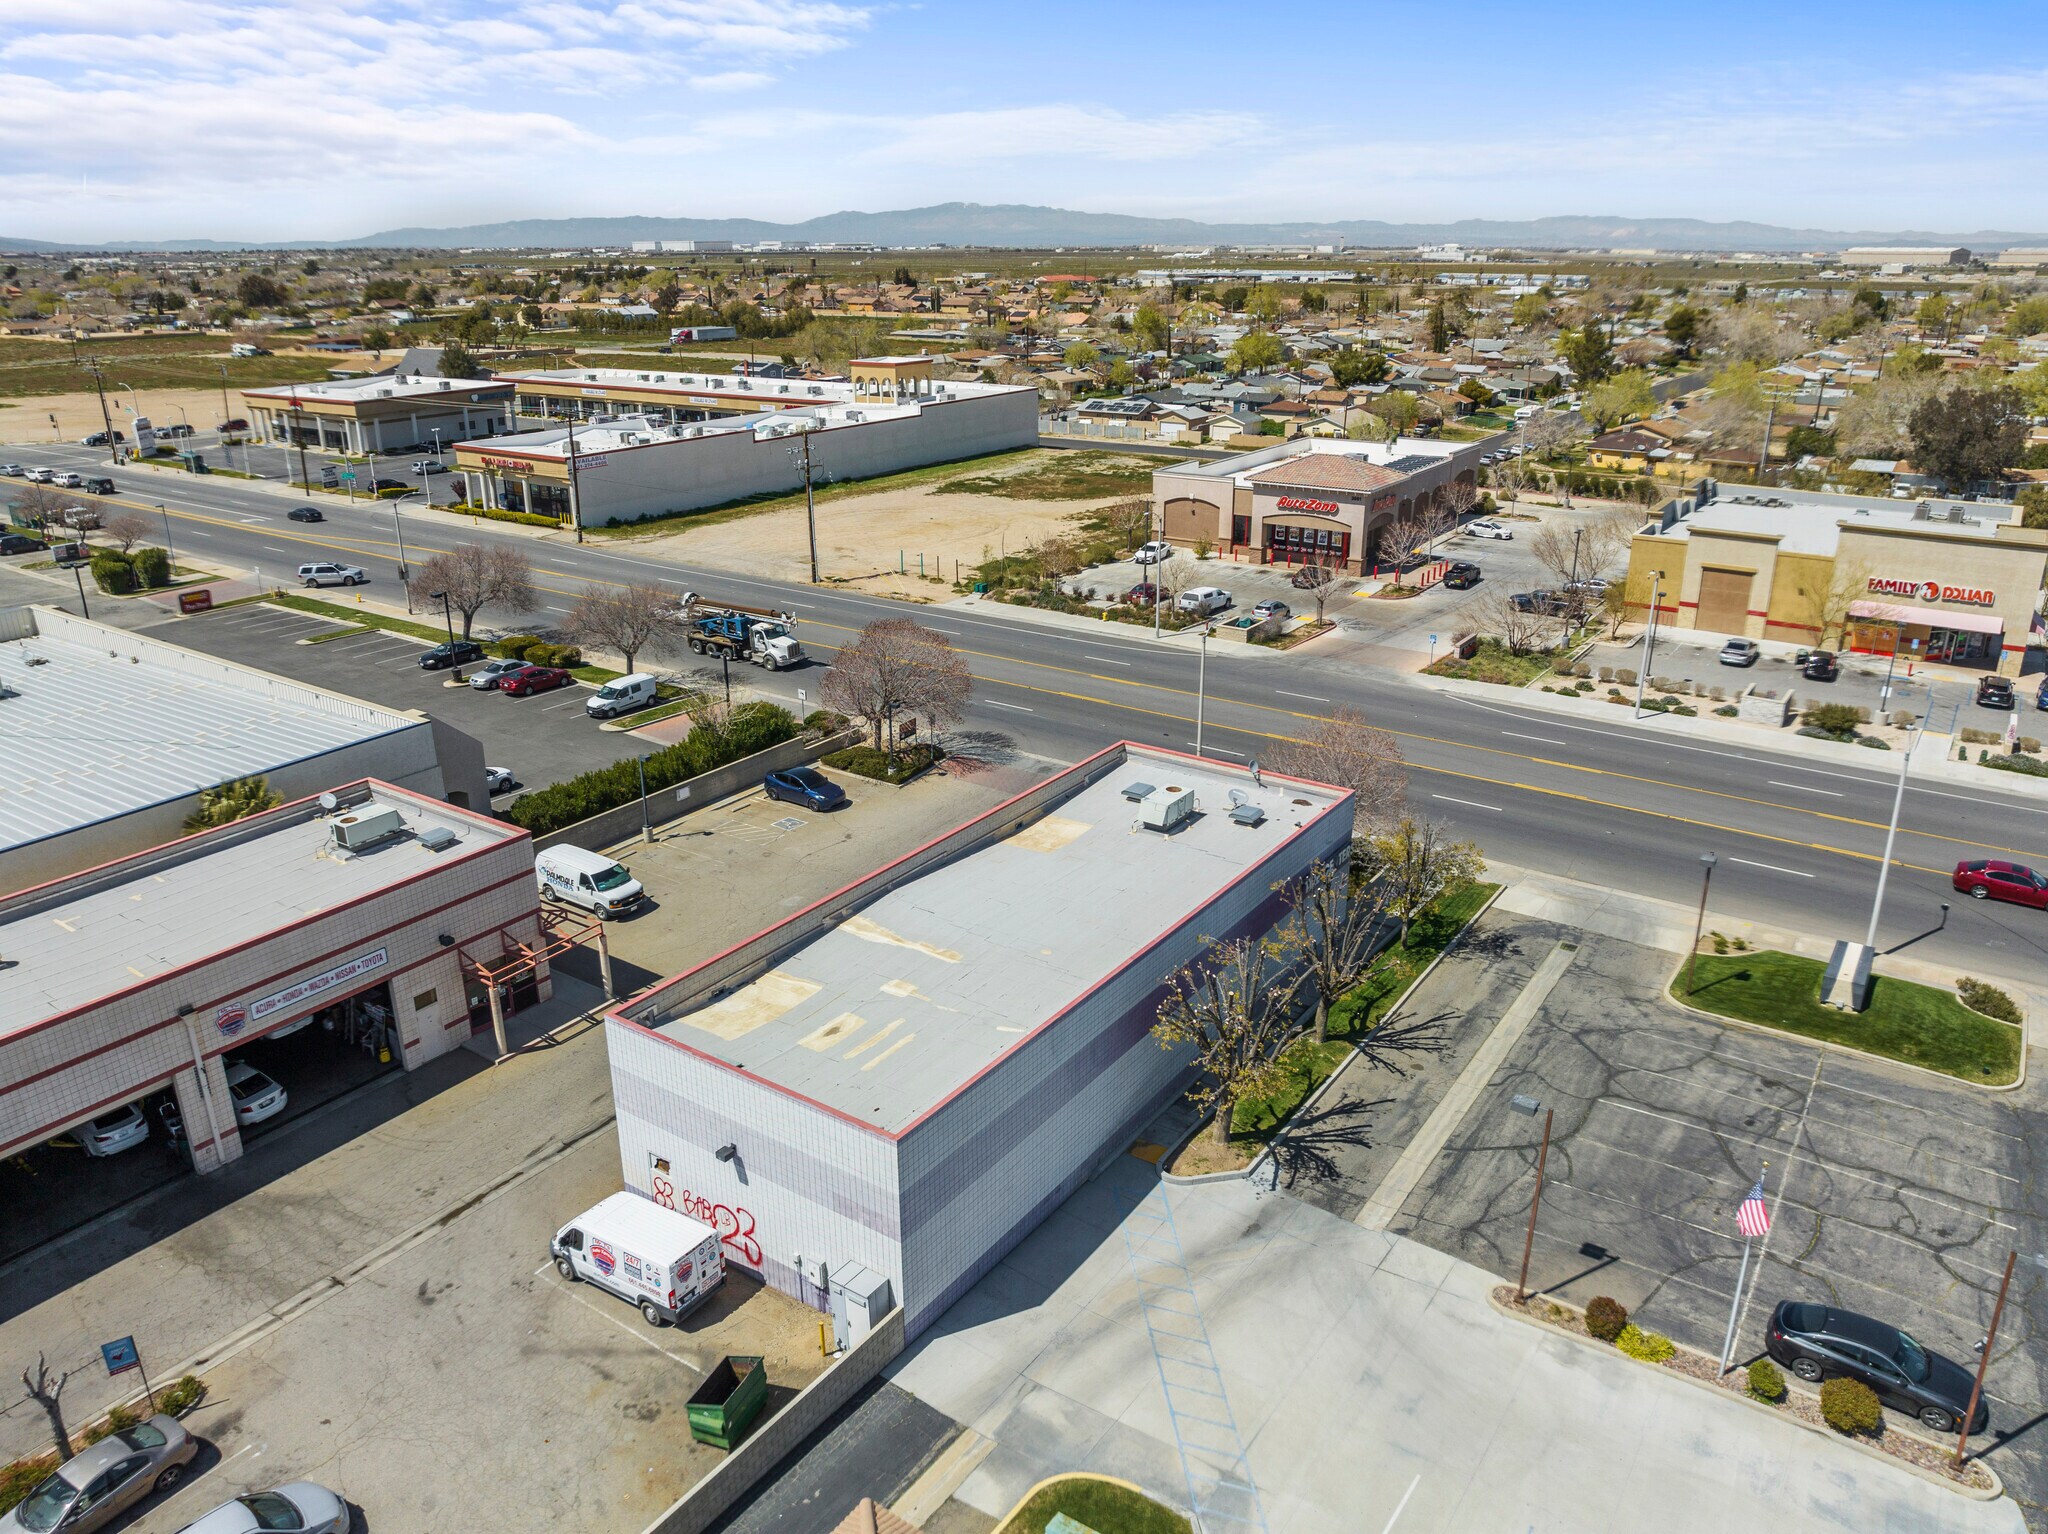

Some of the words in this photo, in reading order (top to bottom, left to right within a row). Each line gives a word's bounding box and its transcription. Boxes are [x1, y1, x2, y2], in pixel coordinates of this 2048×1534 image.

[1276, 495, 1338, 513] AutoZone
[1868, 577, 1919, 595] FAMILY
[1942, 586, 1994, 604] DOLLAR
[546, 870, 574, 887] PALMDALE
[546, 877, 574, 892] HONDA
[255, 998, 277, 1015] ACURA
[282, 987, 304, 1003] HONDA
[308, 975, 330, 992] MAZDA
[334, 964, 358, 981] NISSAN
[361, 952, 384, 969] TOYOTA
[625, 1253, 640, 1267] 24/7
